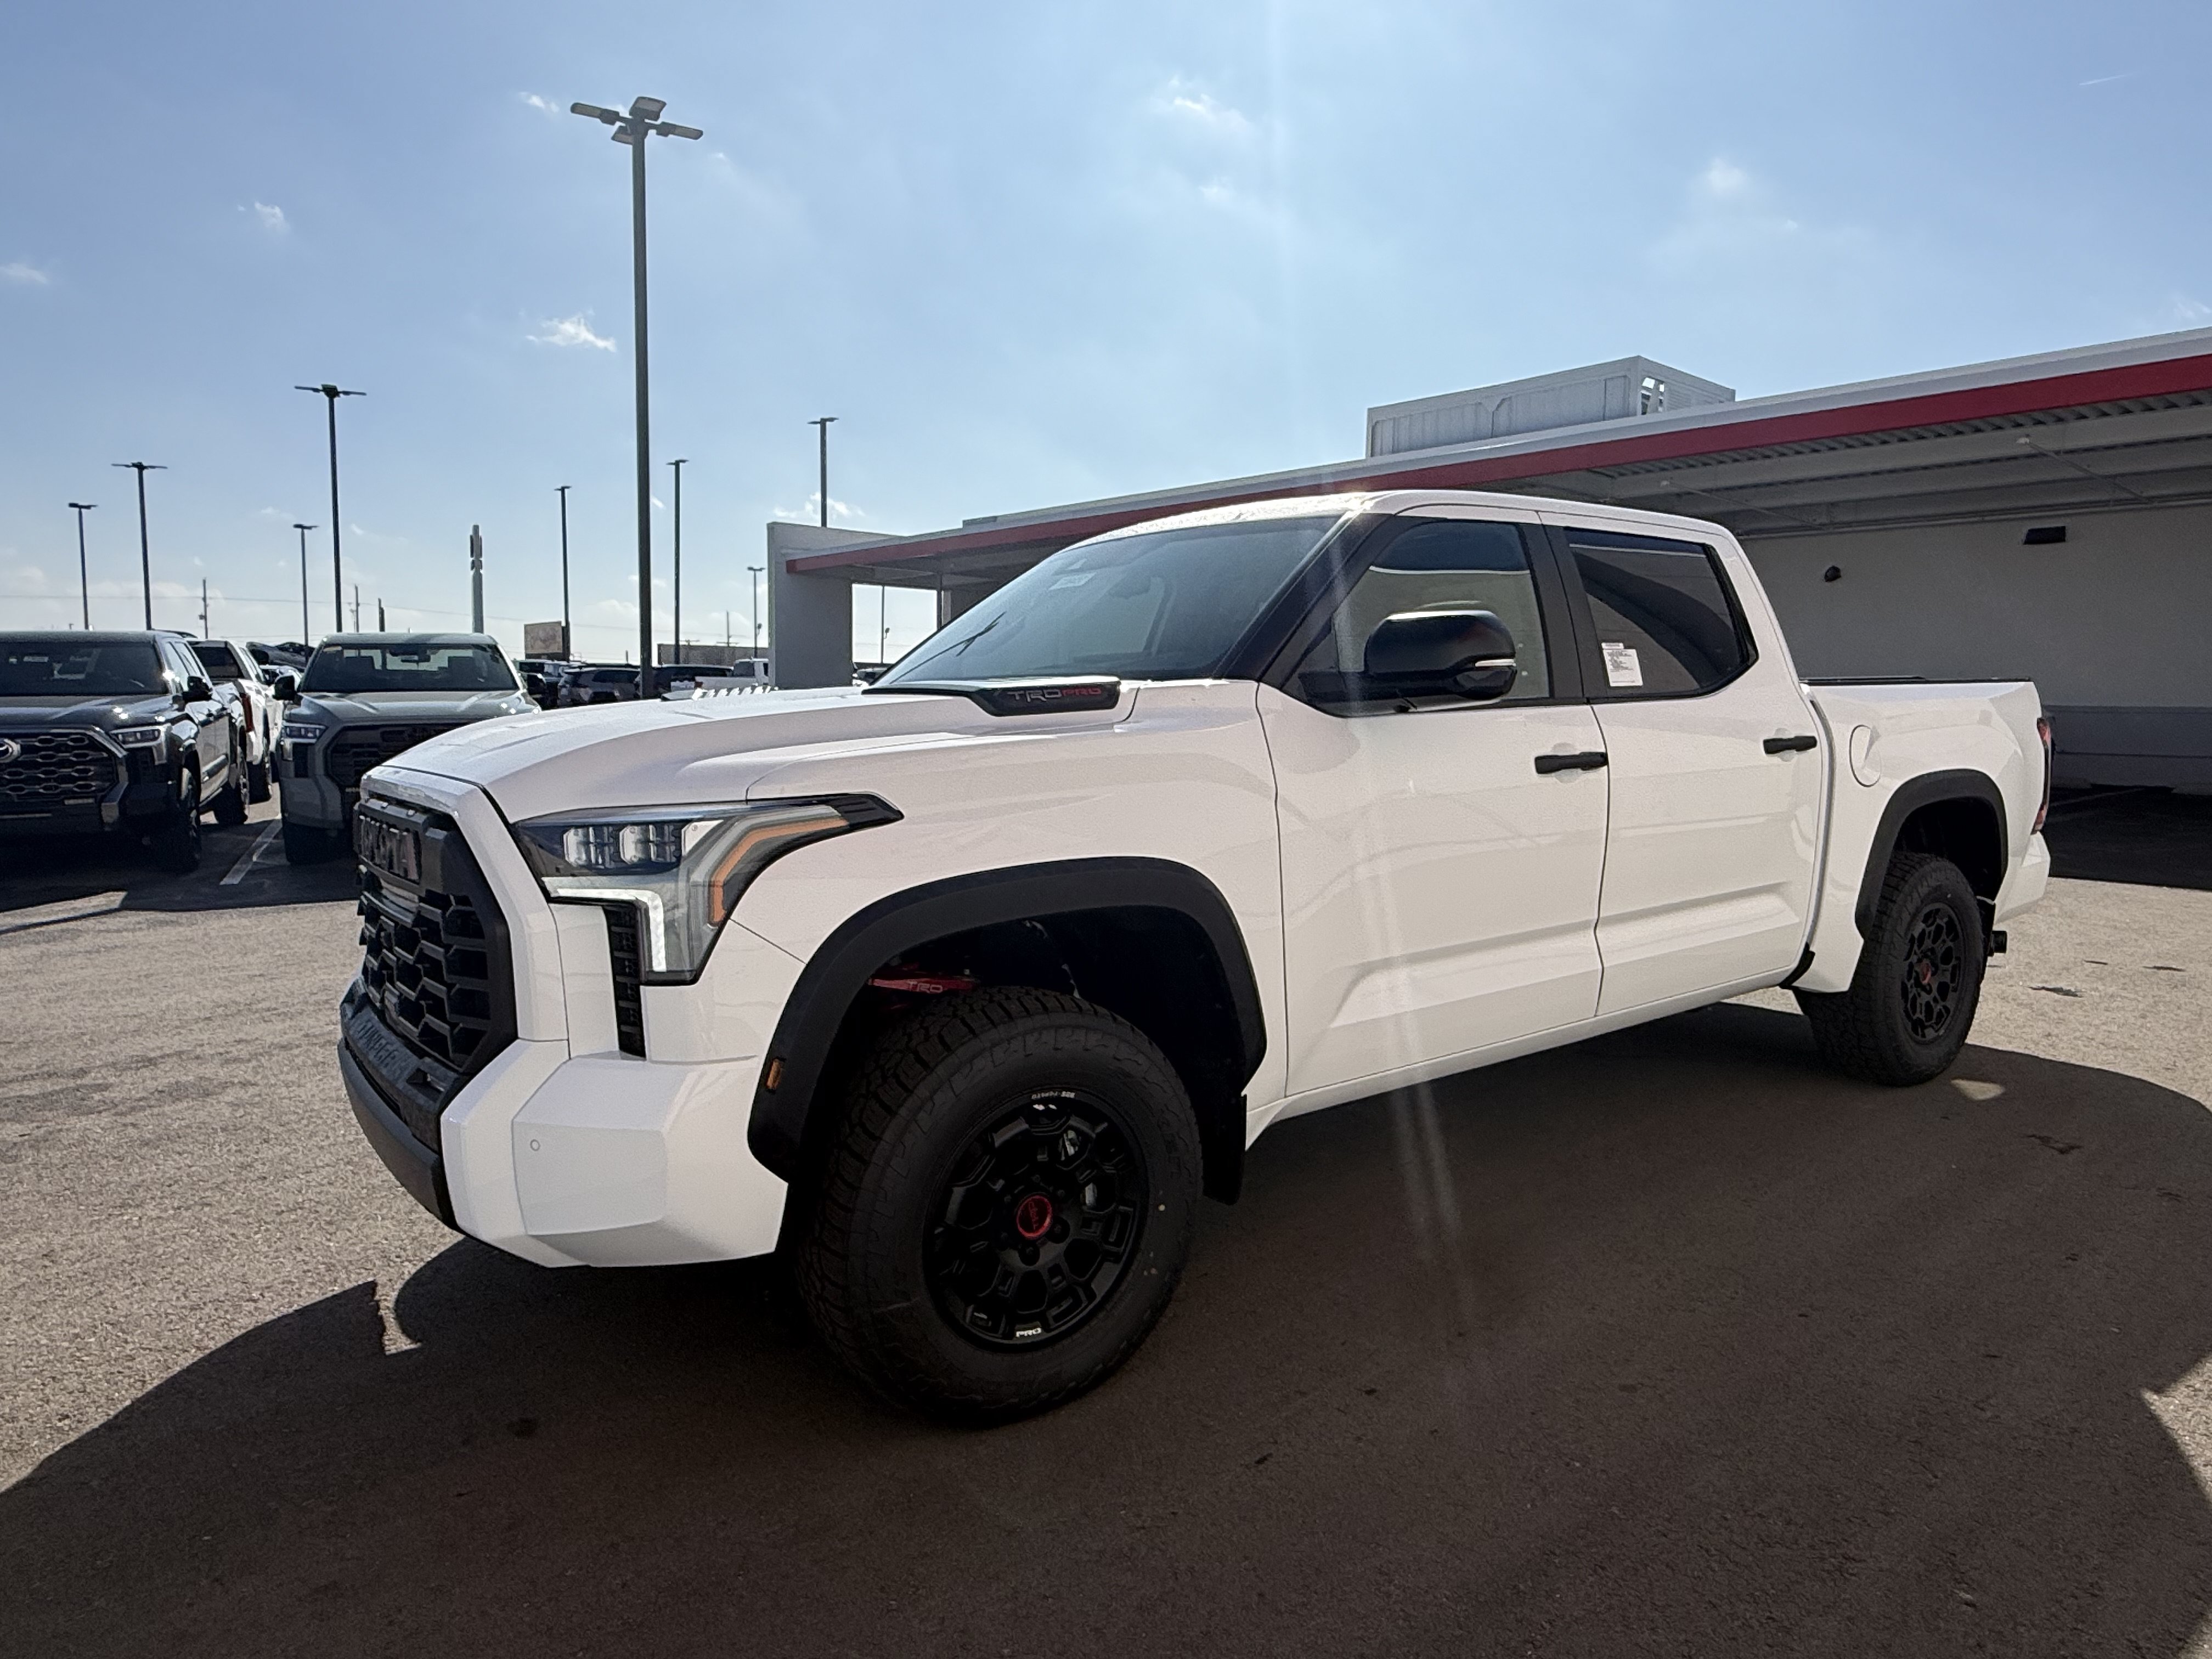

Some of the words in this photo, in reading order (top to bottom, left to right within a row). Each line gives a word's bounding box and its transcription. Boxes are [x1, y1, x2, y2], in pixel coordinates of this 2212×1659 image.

[1007, 689, 1062, 702] TRD
[1062, 687, 1102, 696] PRO
[908, 980, 944, 994] TRD
